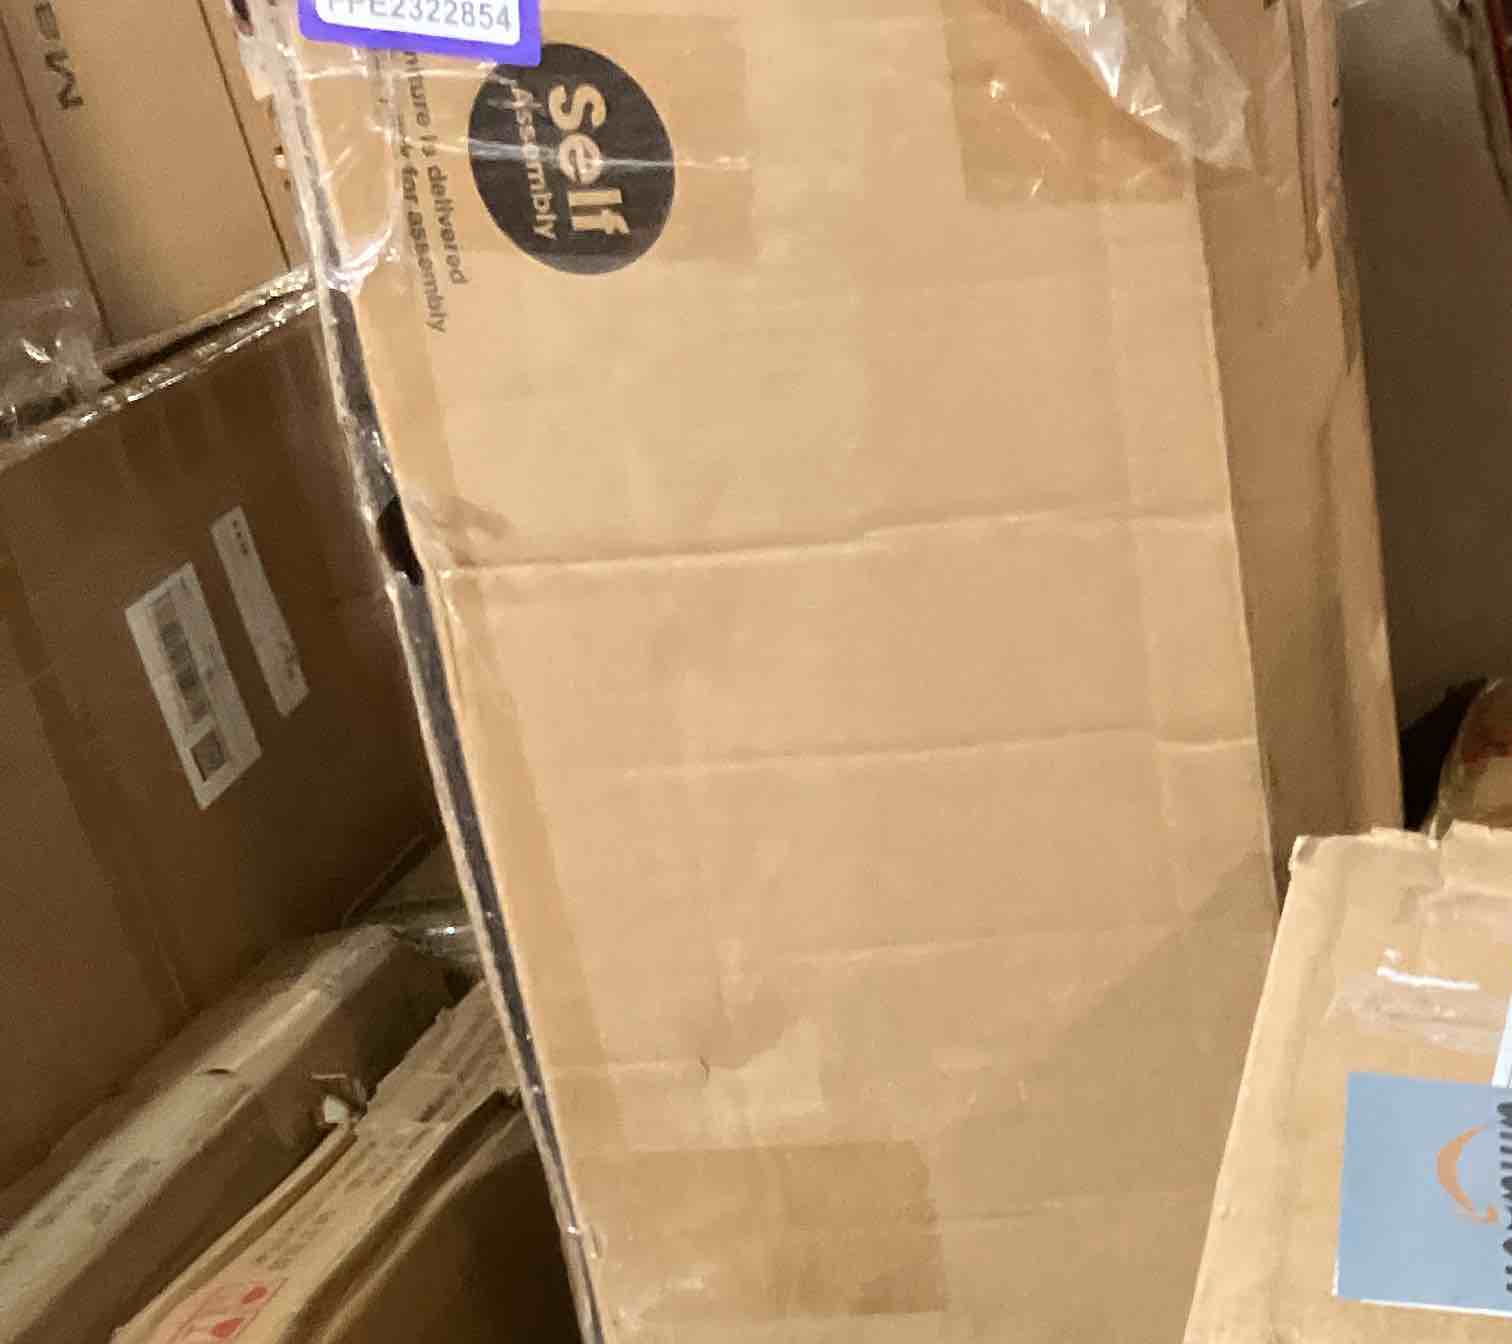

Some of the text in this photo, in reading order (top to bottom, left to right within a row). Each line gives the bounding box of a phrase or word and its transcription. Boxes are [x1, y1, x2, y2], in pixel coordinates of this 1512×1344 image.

[427, 165, 468, 285] delivered
[511, 88, 558, 240] Assembly
[548, 82, 631, 236] Self
